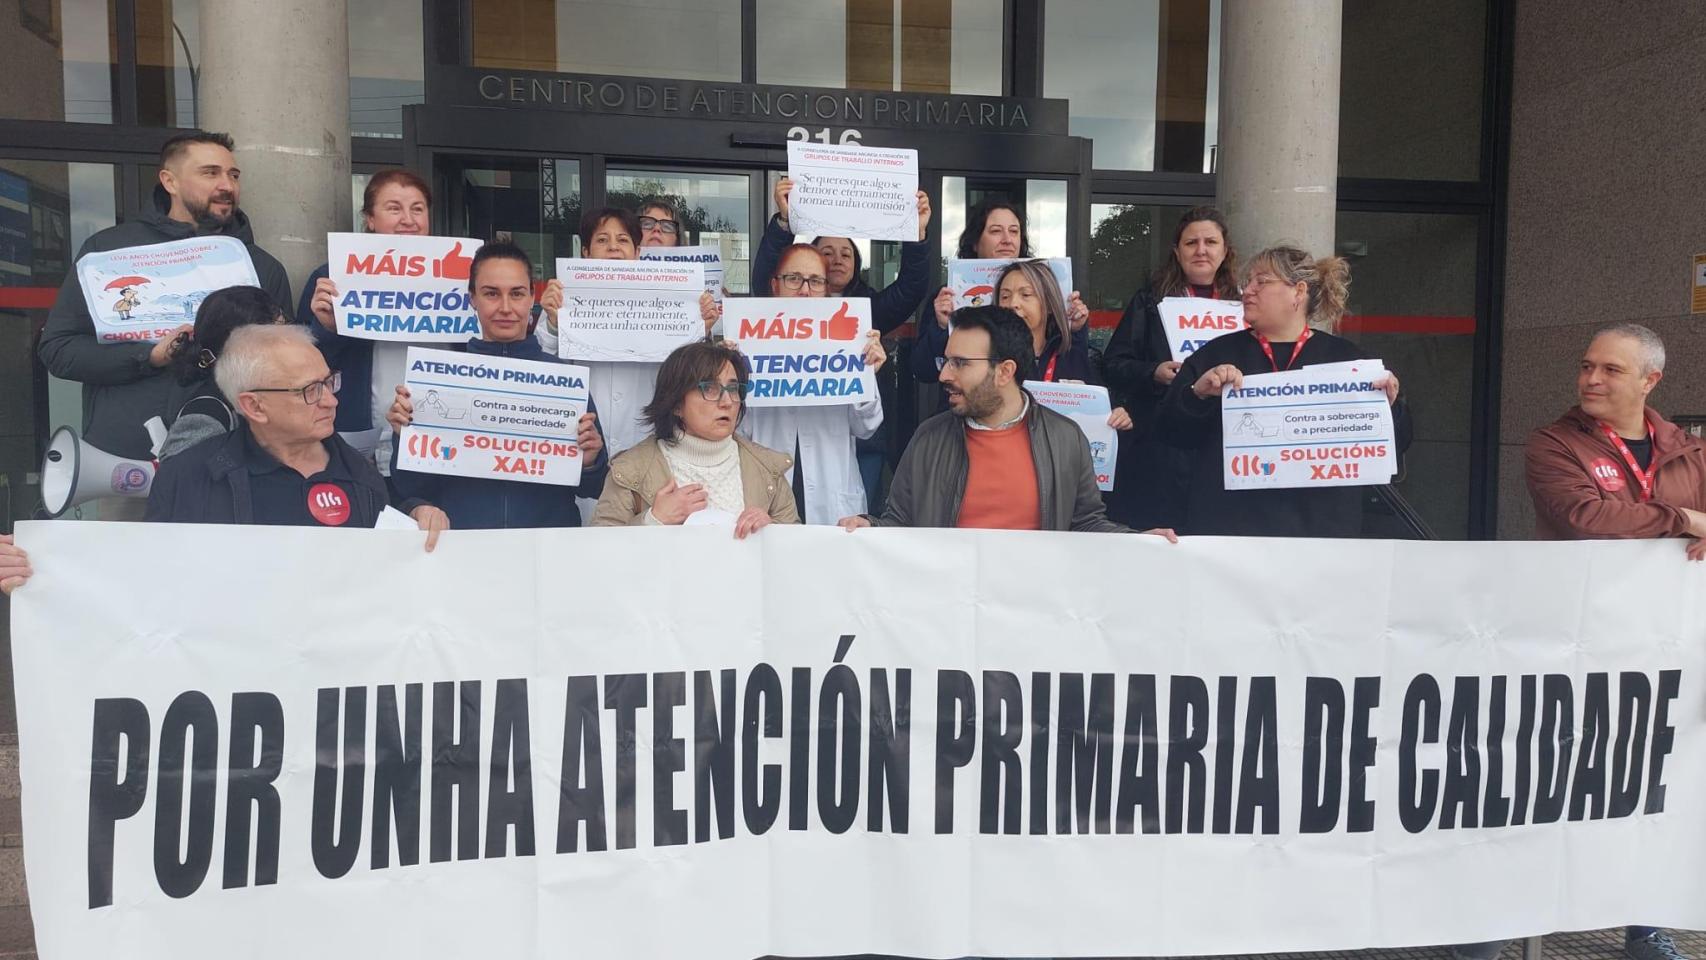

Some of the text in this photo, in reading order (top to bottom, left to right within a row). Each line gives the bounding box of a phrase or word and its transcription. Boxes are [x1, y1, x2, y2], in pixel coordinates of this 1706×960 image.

[479, 75, 625, 107] CENTRO
[636, 85, 680, 111] DE
[874, 98, 1029, 127] PRIMARIA
[804, 153, 831, 161] GRUPOS
[841, 156, 872, 164] TRABALLO
[798, 183, 839, 196] demore
[849, 178, 869, 189] que
[869, 177, 891, 189] algo
[798, 196, 833, 206] nomea
[834, 197, 861, 208] unha
[346, 249, 426, 277] MÁIS
[575, 272, 605, 280] GRUPOS
[588, 298, 625, 310] queres
[626, 300, 648, 311] que
[648, 297, 672, 310] algo
[569, 308, 614, 318] demore
[1178, 311, 1238, 330] MÁIS
[347, 313, 480, 334] PRIMARIA
[569, 320, 608, 330] nomea
[610, 320, 638, 330] unha
[739, 312, 814, 340] MÁIS
[103, 330, 152, 341] CHOVE
[411, 359, 585, 389] ATENCIÓN PRIMARIA
[1226, 381, 1382, 399] ATENCIÓN PRIMARI
[473, 399, 508, 411] Contra
[519, 404, 576, 417] sobrecarga
[499, 414, 567, 429] precariedade
[1285, 414, 1317, 423] Contra
[1327, 411, 1380, 421] sobrecarga
[1310, 423, 1373, 435] precariedade
[463, 435, 578, 457] SOLUCIÓNS
[1280, 444, 1387, 461] SOLUCIÓNS
[492, 455, 546, 476] XA!!
[1310, 463, 1359, 480] XA!!
[88, 635, 1682, 910] POR UNHA ATENCIÓN PRIMARIA DE CALIDADE
